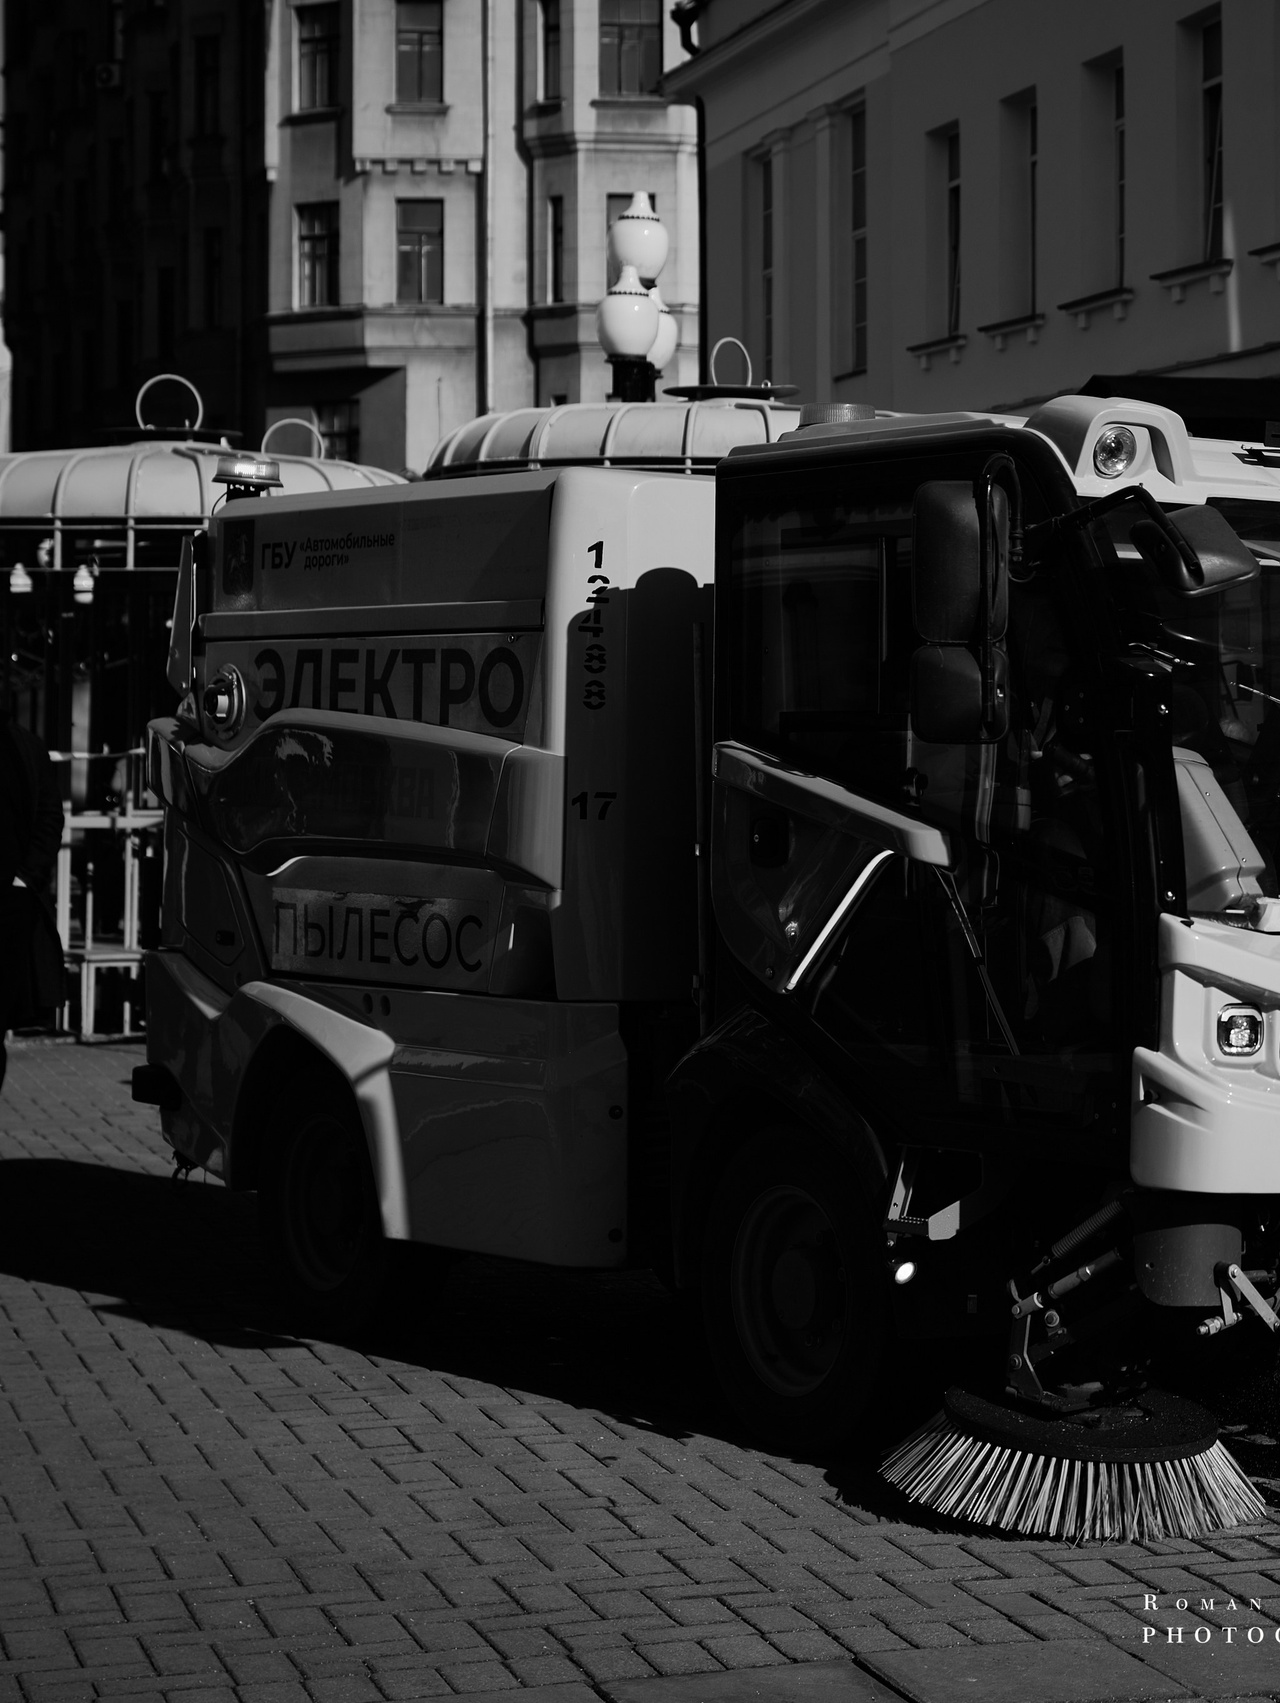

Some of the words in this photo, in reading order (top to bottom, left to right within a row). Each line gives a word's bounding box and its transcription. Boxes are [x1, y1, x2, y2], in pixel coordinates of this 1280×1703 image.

[261, 541, 297, 570] ГБУ
[300, 532, 395, 552] «Автомобильные
[304, 554, 349, 571] дороги»
[253, 646, 525, 728] ЭЛЕКТРО
[572, 792, 617, 820] 17
[275, 900, 483, 973] ПЫЛЕСОС
